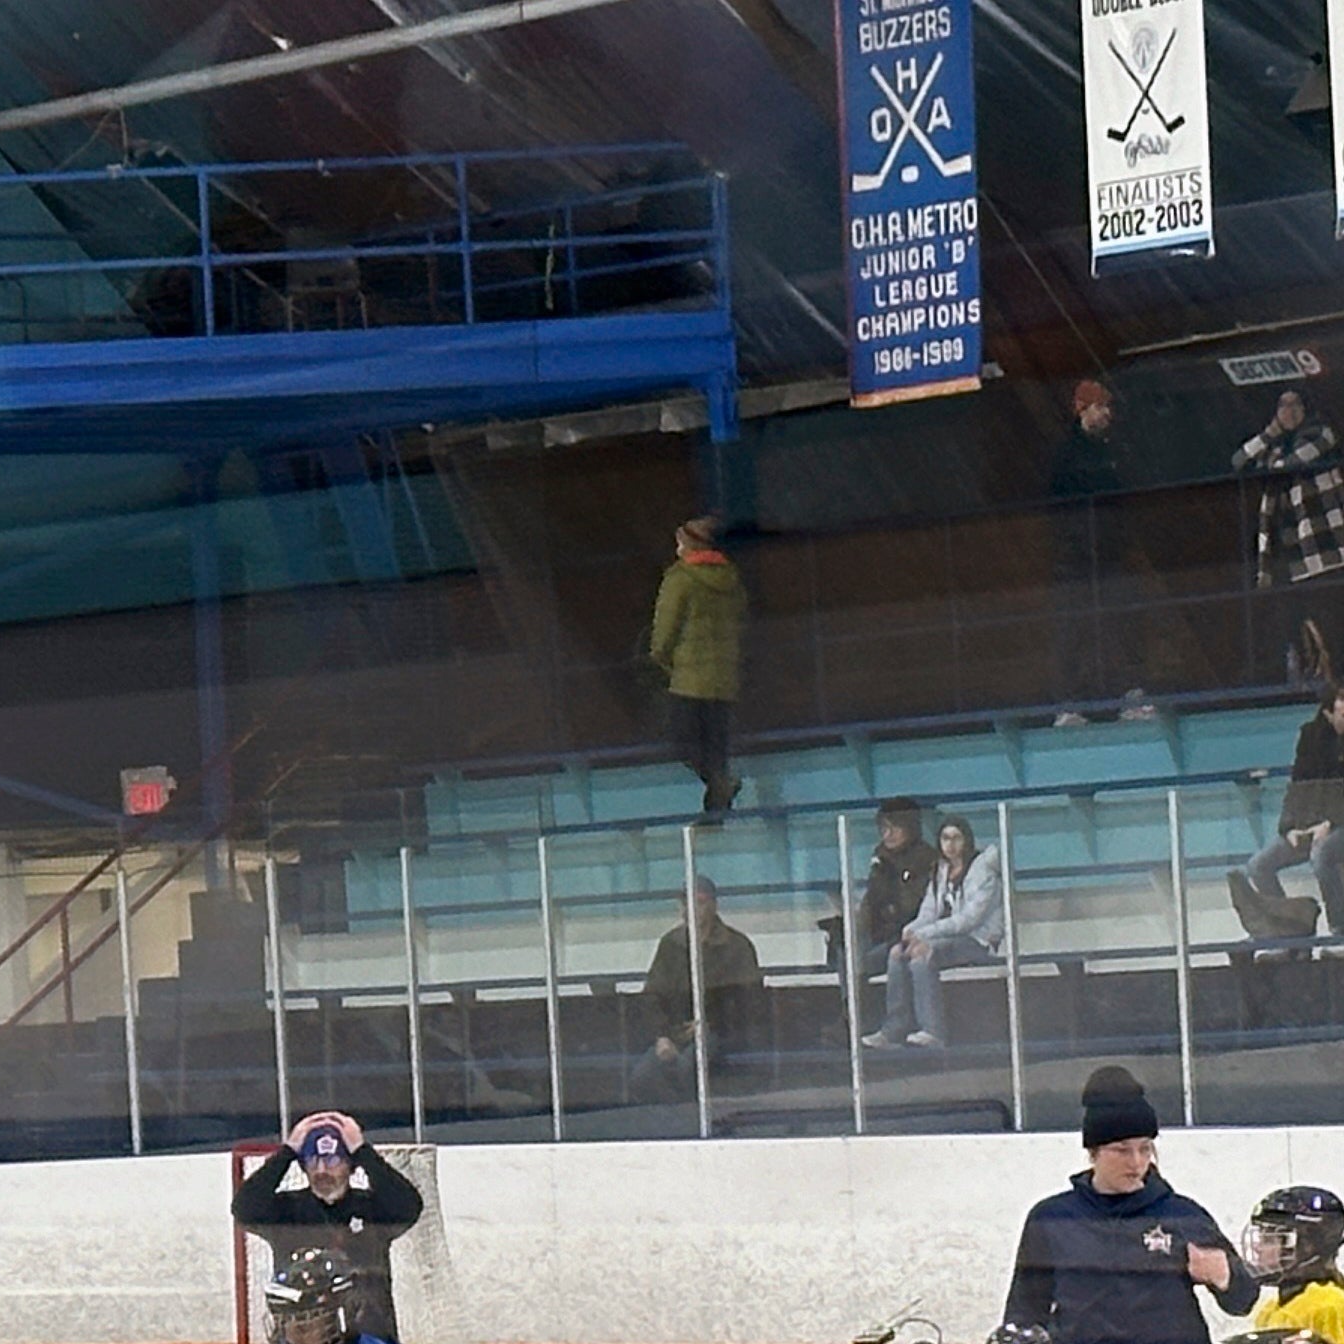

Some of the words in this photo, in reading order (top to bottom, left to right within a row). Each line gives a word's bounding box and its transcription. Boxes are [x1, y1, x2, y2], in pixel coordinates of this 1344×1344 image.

[859, 6, 951, 54] BUZZERS
[896, 57, 918, 92] H
[926, 97, 952, 134] A
[1097, 171, 1202, 211] FINALISTS
[907, 197, 978, 241] METRO
[1098, 198, 1204, 242] 2002-2003
[860, 244, 936, 280] JUNIOR
[874, 270, 958, 308] LEAGUE
[857, 297, 980, 342] CHAMPIONS
[1228, 356, 1299, 381] SECTION
